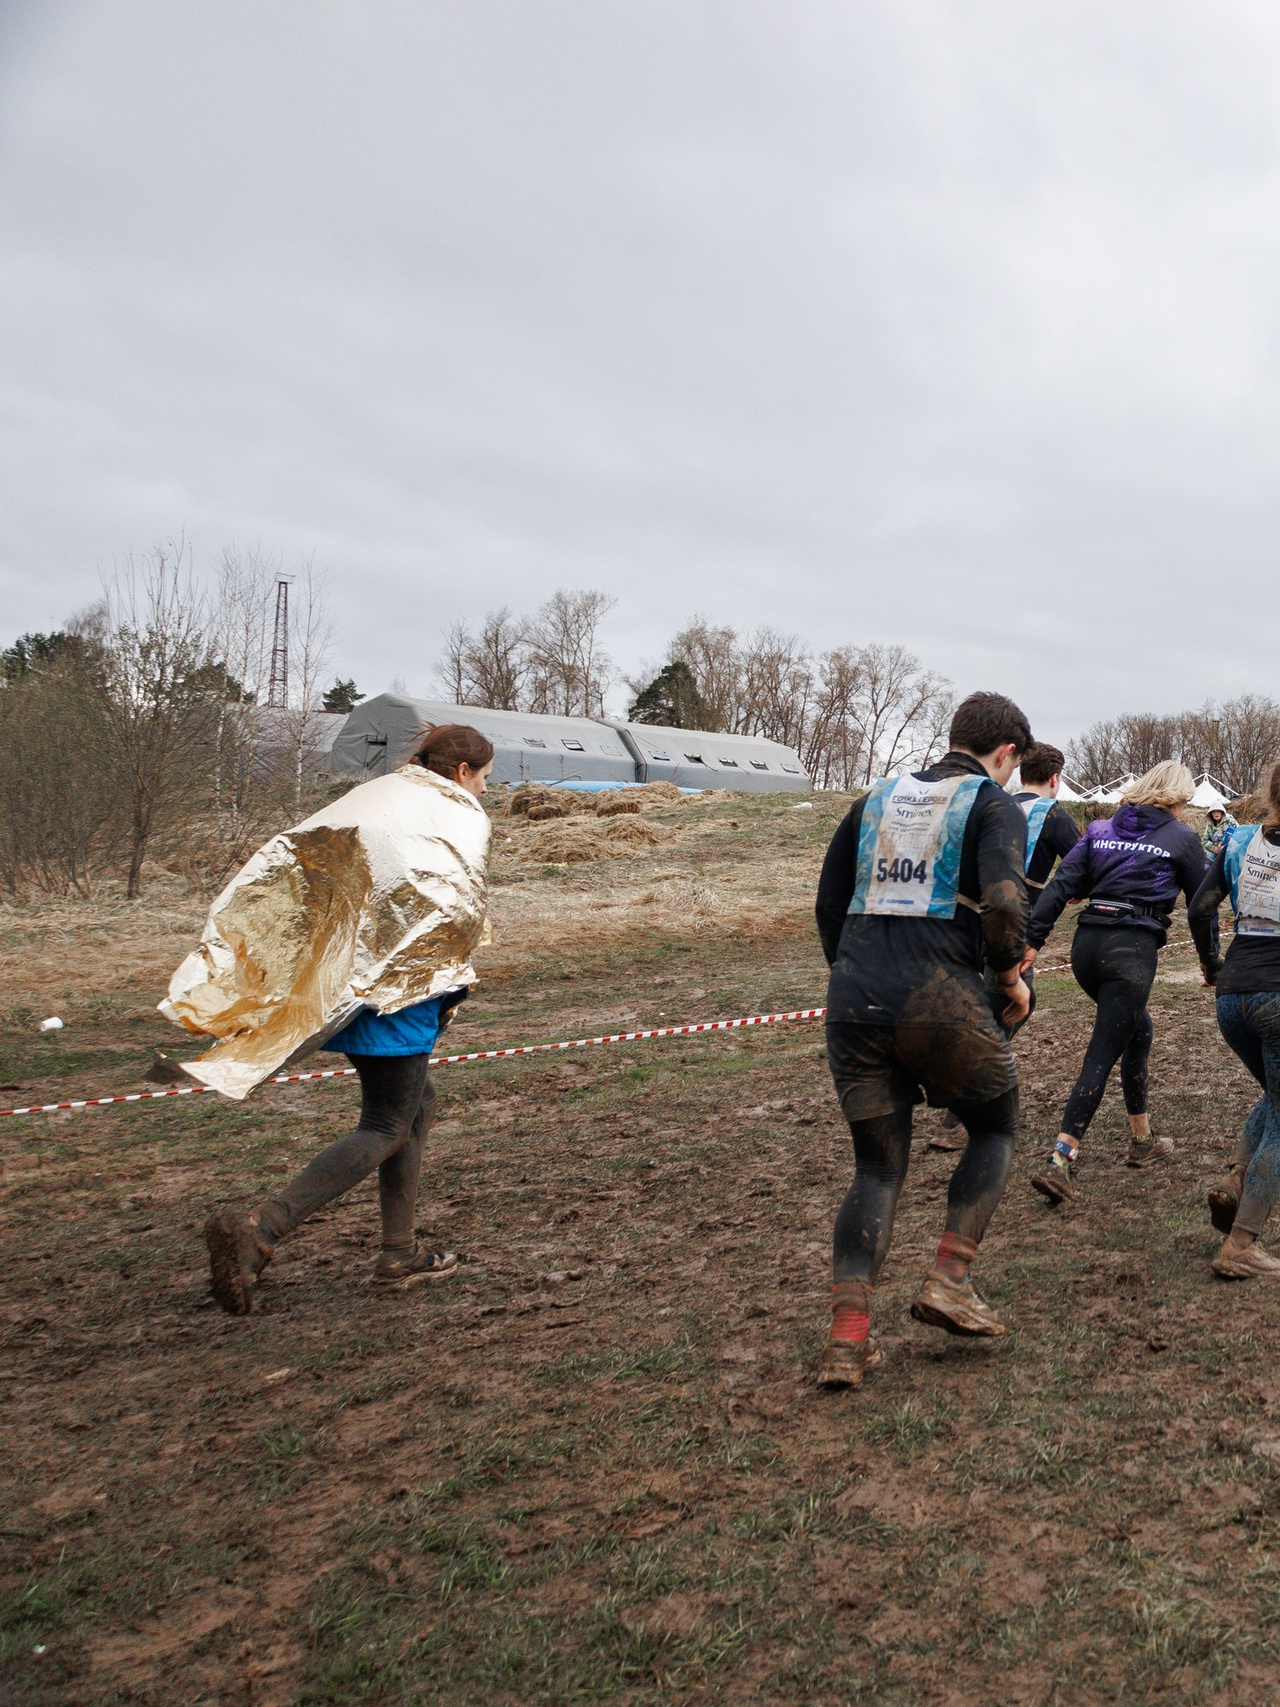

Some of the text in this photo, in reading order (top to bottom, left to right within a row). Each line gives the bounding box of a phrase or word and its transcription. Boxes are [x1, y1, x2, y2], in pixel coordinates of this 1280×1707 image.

[895, 806, 934, 819] Sminex
[1092, 839, 1171, 858] ИНСТРУКТОР
[1245, 853, 1265, 865] ГОНКА
[876, 857, 928, 885] 5404
[1246, 866, 1278, 882] Sminex
